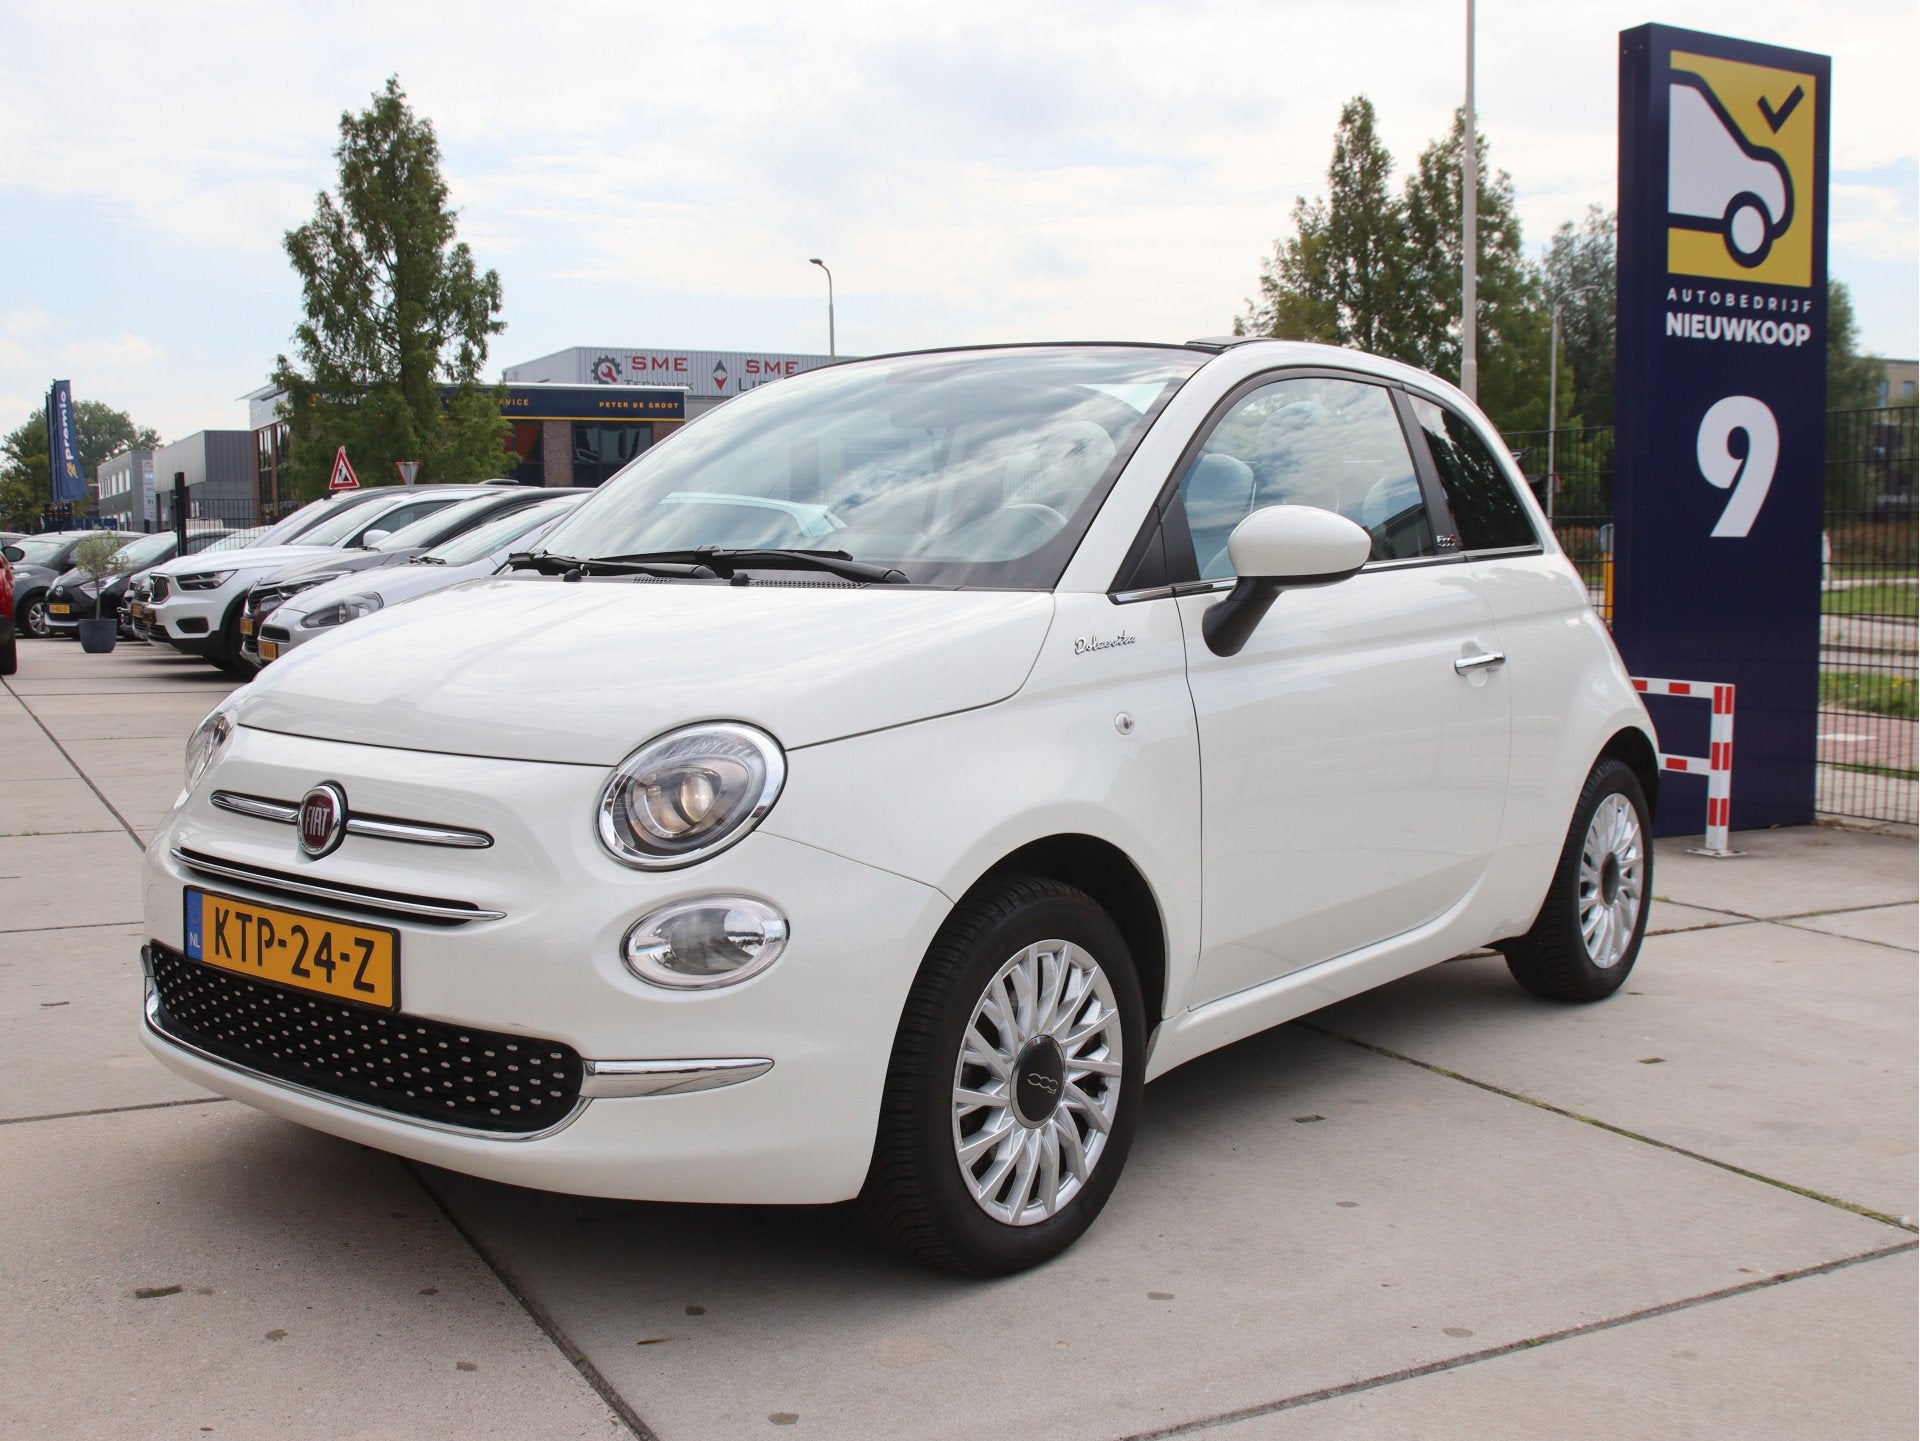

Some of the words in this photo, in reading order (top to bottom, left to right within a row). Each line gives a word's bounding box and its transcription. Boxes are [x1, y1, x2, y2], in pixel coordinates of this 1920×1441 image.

[1667, 287, 1812, 314] AUTOBEDRIJF
[1666, 311, 1812, 347] NIEUWKOOP
[631, 356, 688, 372] SME
[745, 359, 799, 375] SME
[59, 390, 74, 460] premio
[1696, 395, 1780, 538] 9
[305, 805, 331, 837] FIAT
[189, 931, 201, 949] NL
[214, 906, 375, 993] KTP-24-Z
